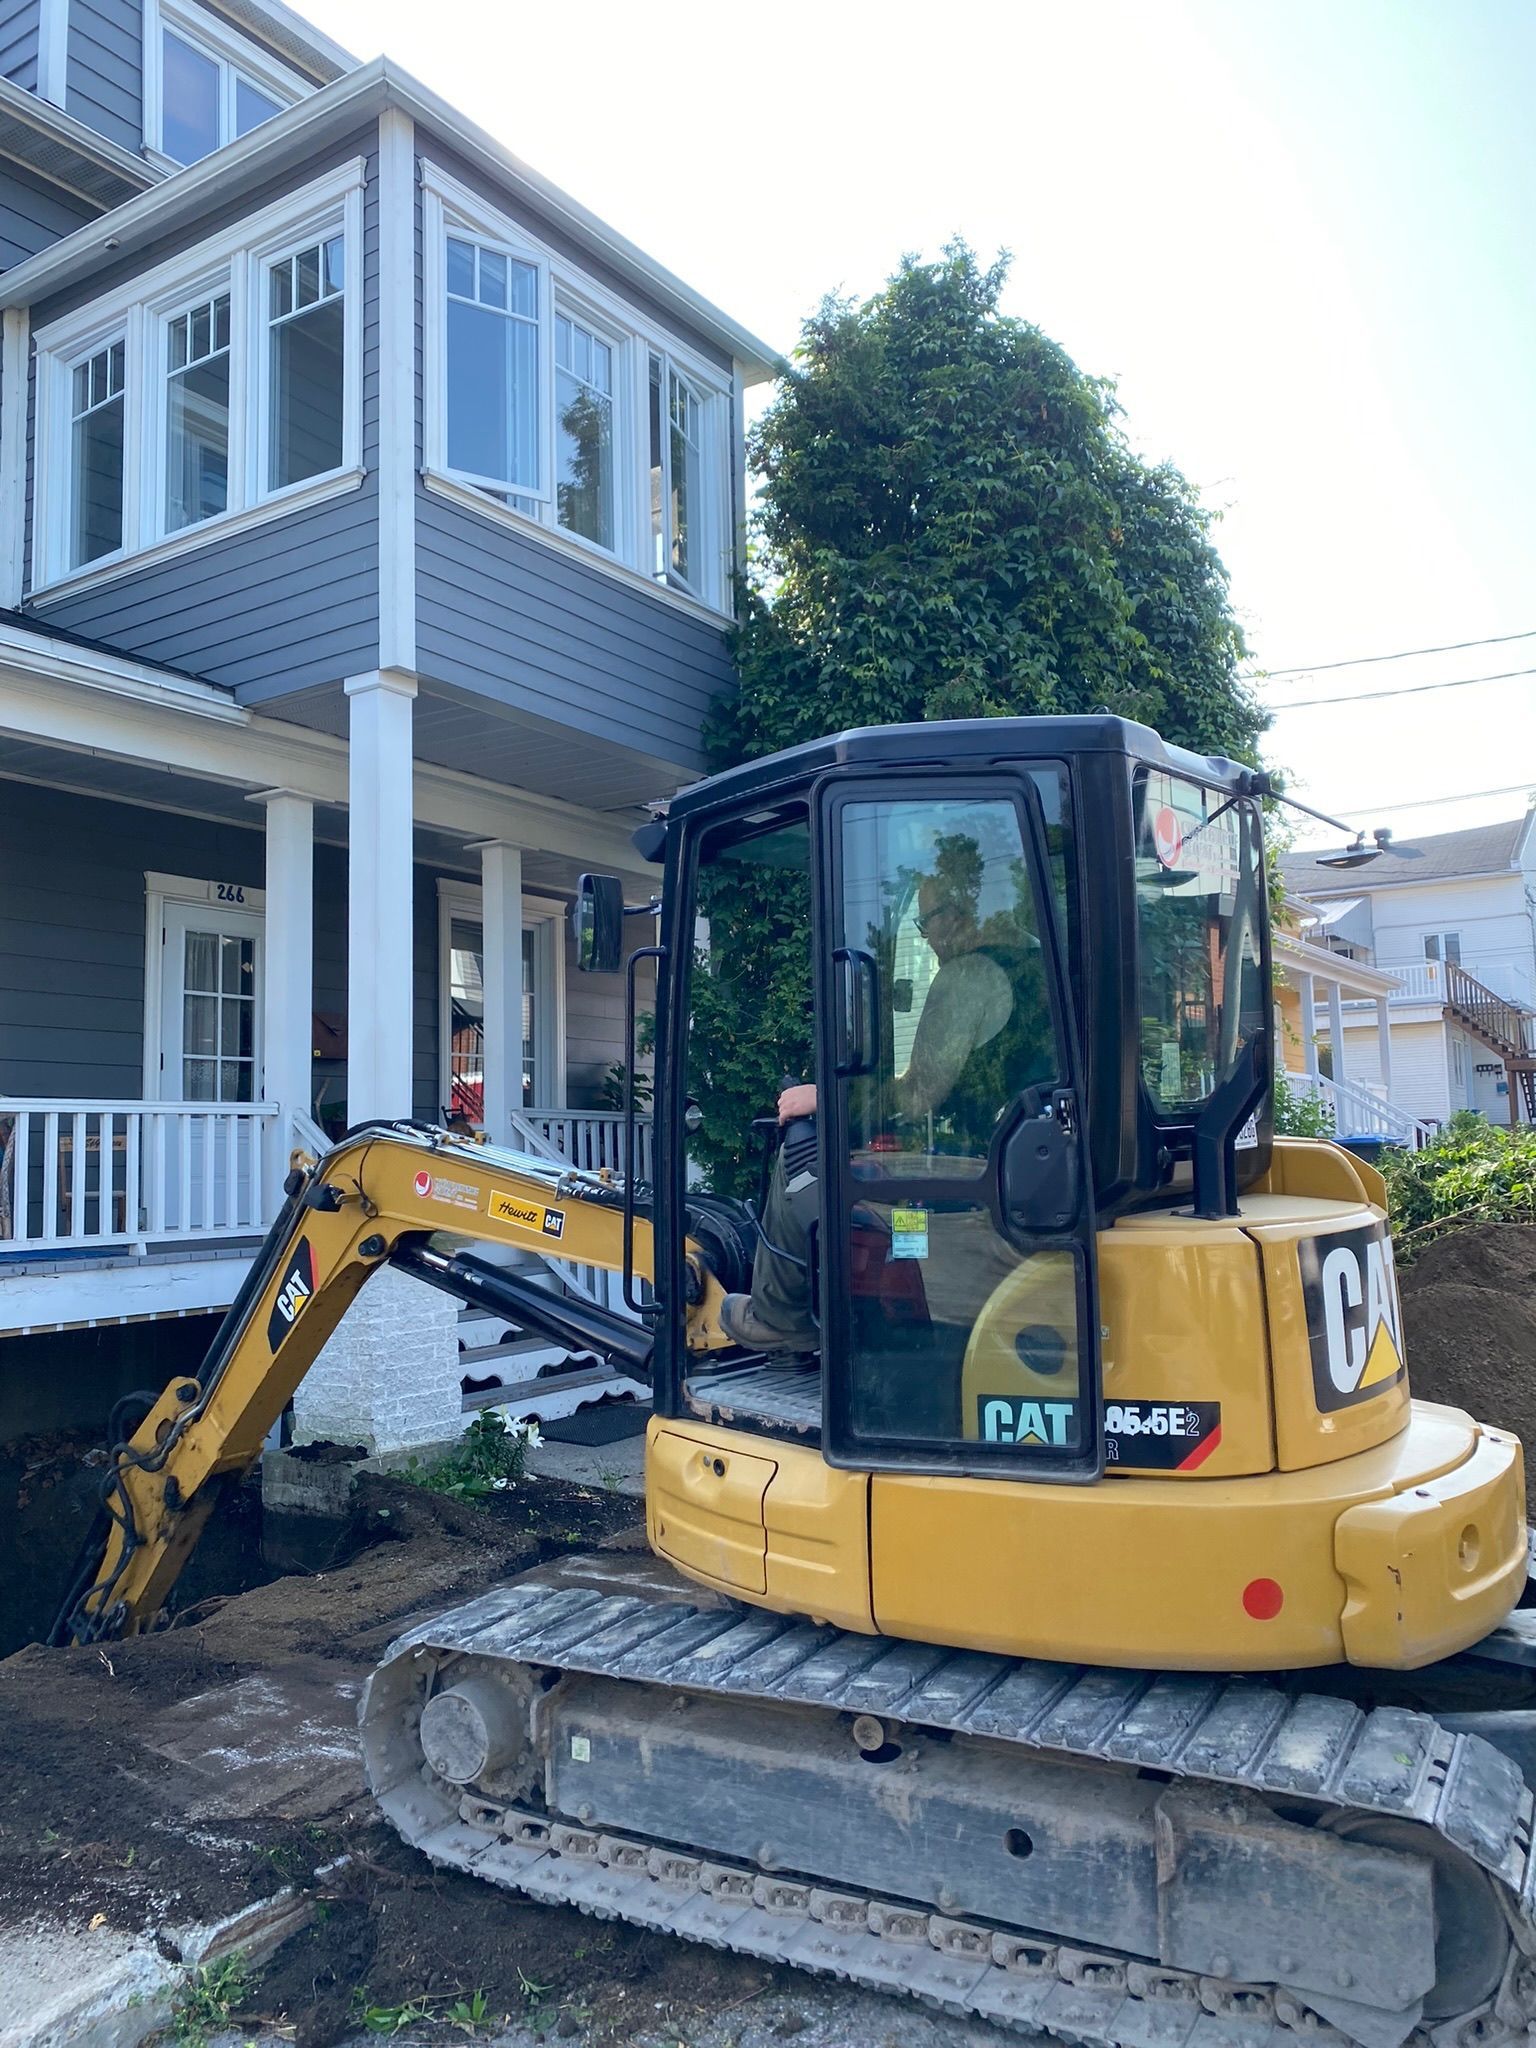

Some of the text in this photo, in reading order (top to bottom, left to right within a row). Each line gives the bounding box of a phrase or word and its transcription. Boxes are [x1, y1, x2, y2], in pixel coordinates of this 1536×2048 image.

[217, 884, 245, 903] 266
[498, 1202, 562, 1231] Hewitt CAT
[277, 1269, 311, 1322] CAT
[1323, 1235, 1404, 1393] CAT
[984, 1401, 1074, 1446] CAT
